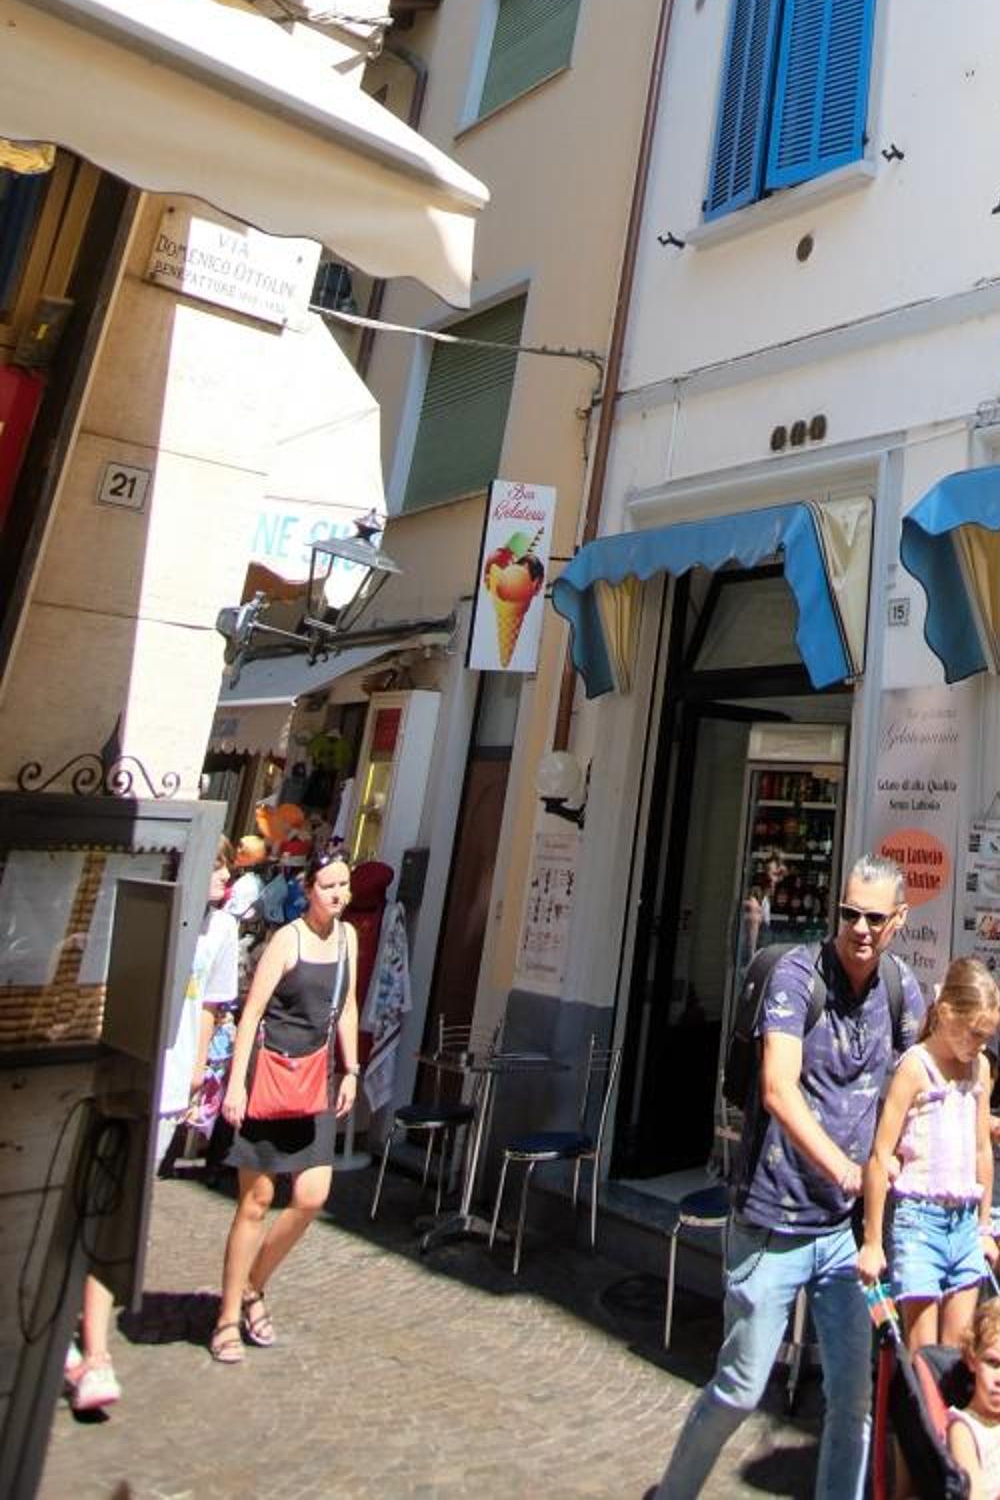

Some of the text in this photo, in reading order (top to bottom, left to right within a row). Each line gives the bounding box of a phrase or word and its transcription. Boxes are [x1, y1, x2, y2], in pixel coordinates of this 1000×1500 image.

[218, 232, 250, 258] VIA
[110, 471, 137, 499] 21
[894, 604, 905, 620] 15
